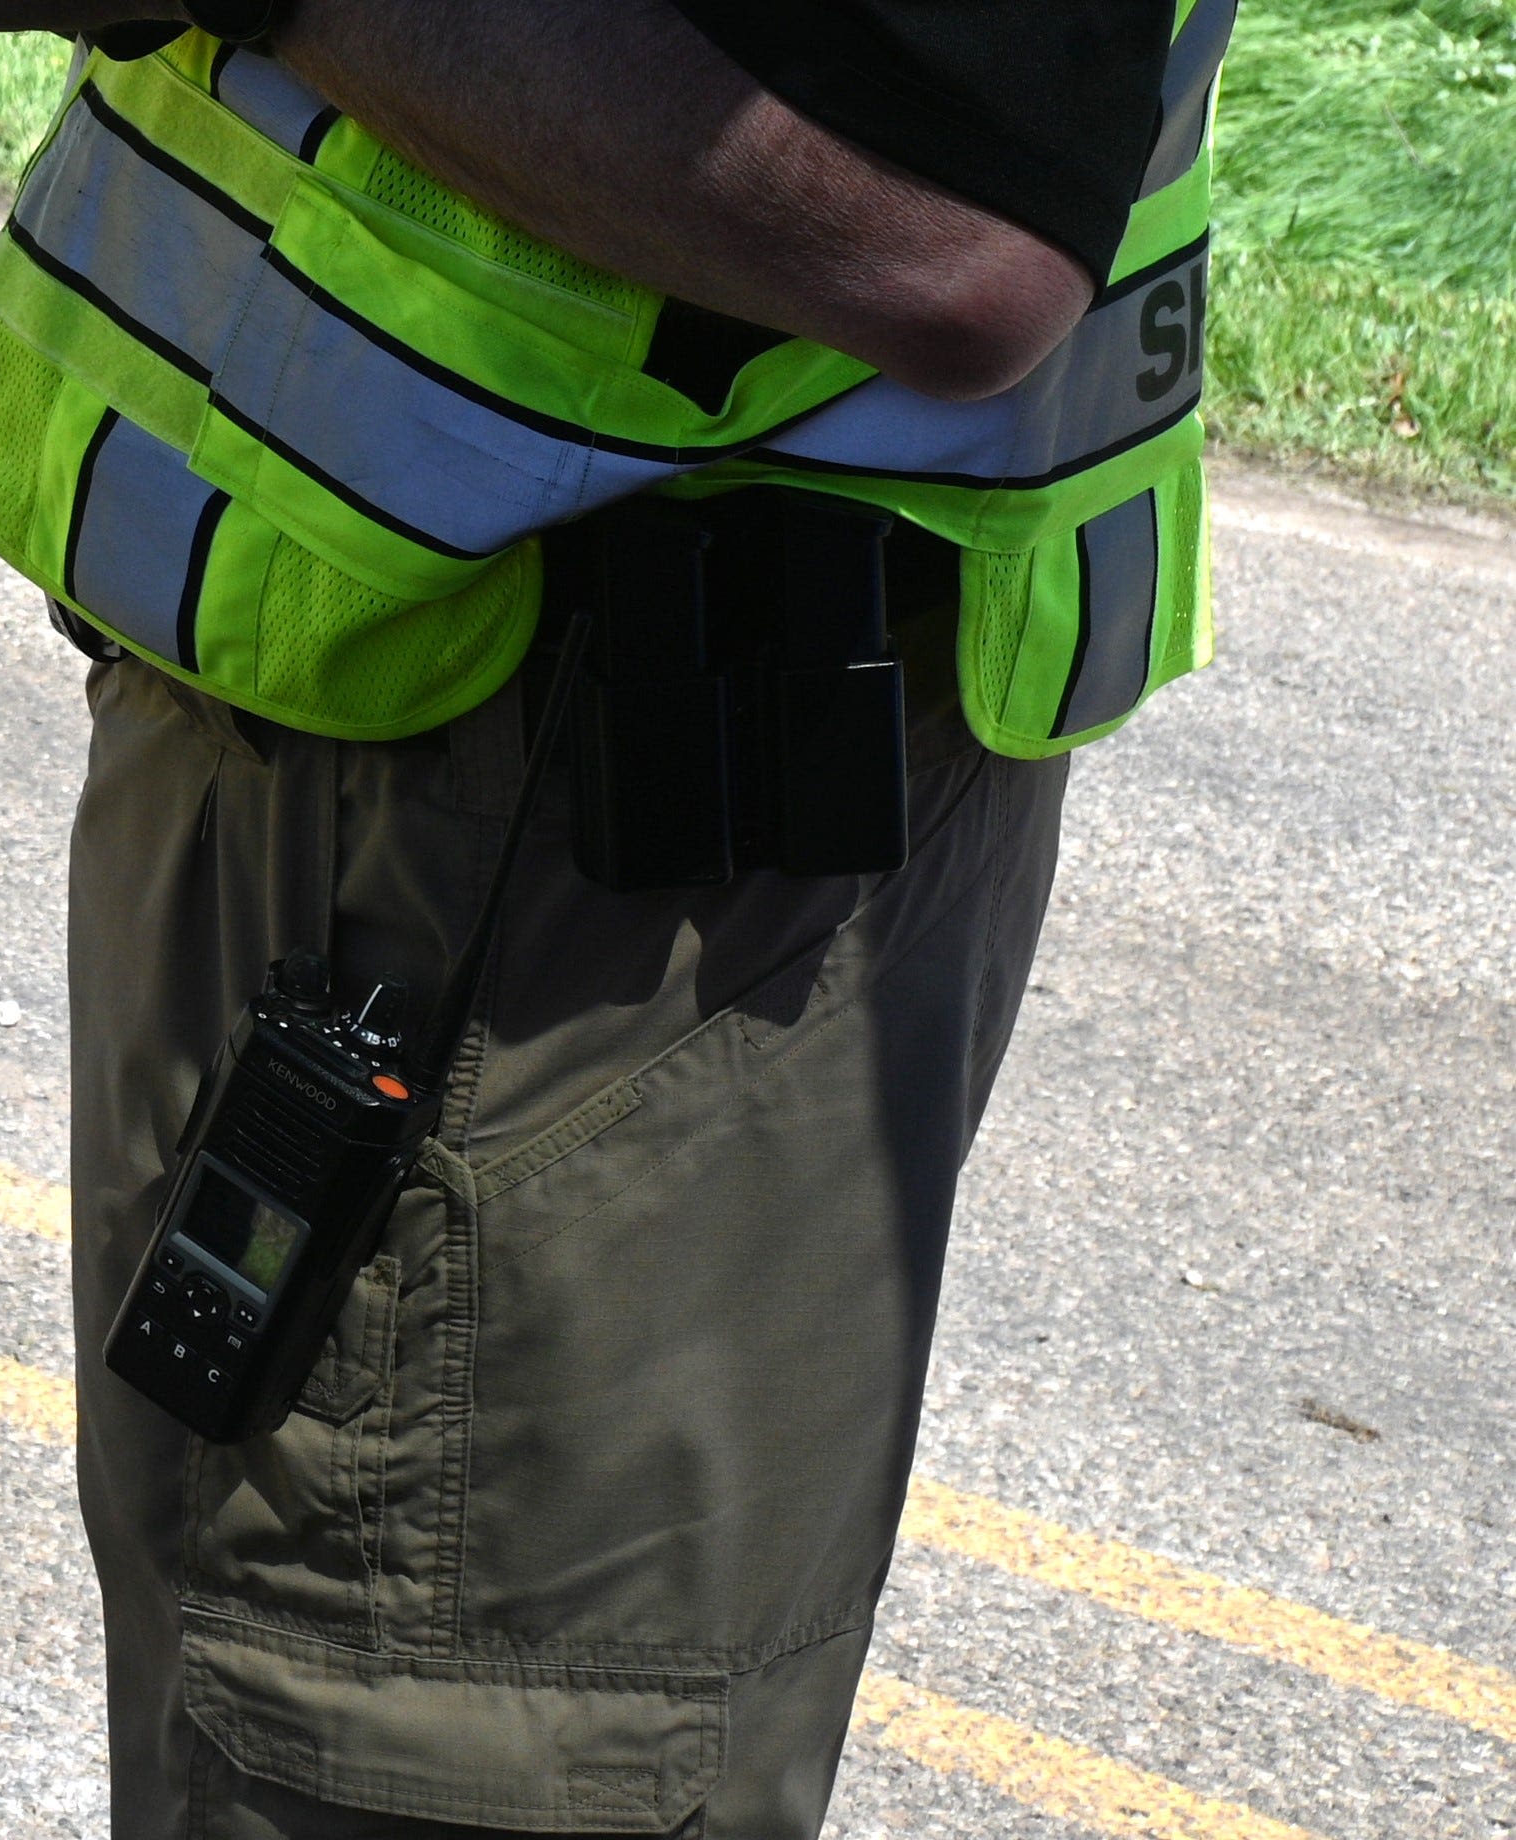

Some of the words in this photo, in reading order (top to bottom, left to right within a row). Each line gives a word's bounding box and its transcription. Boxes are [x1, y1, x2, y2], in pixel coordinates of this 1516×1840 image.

[268, 1058, 336, 1110] KENWOOD
[140, 1321, 151, 1335] A
[174, 1344, 186, 1359] B
[208, 1369, 220, 1383] C
